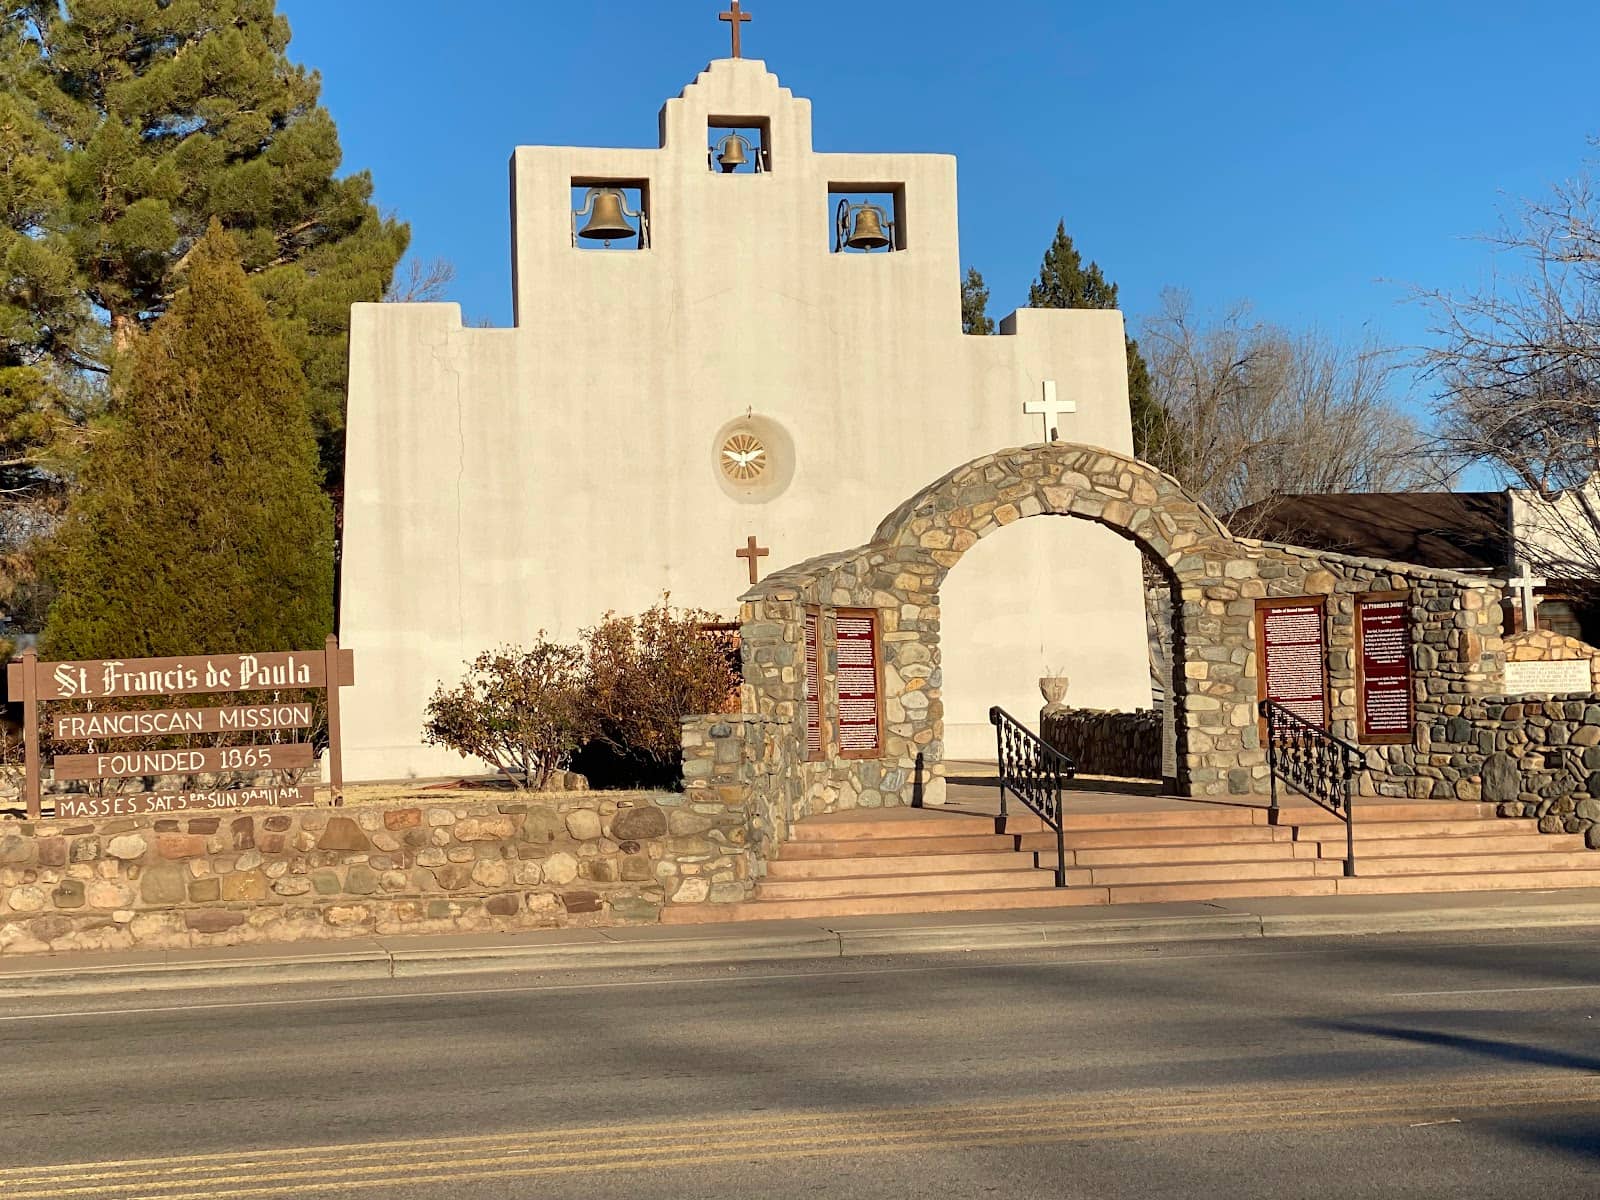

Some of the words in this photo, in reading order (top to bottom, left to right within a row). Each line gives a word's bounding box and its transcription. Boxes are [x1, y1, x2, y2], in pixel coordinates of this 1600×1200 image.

[102, 661, 198, 696] Francis
[205, 660, 232, 688] de
[238, 655, 310, 690] Paula
[58, 711, 202, 737] FRANCISCAN
[219, 706, 309, 729] MISSION
[97, 751, 205, 775] FOUNDED
[219, 748, 272, 769] 1865
[60, 797, 137, 816] MASSES
